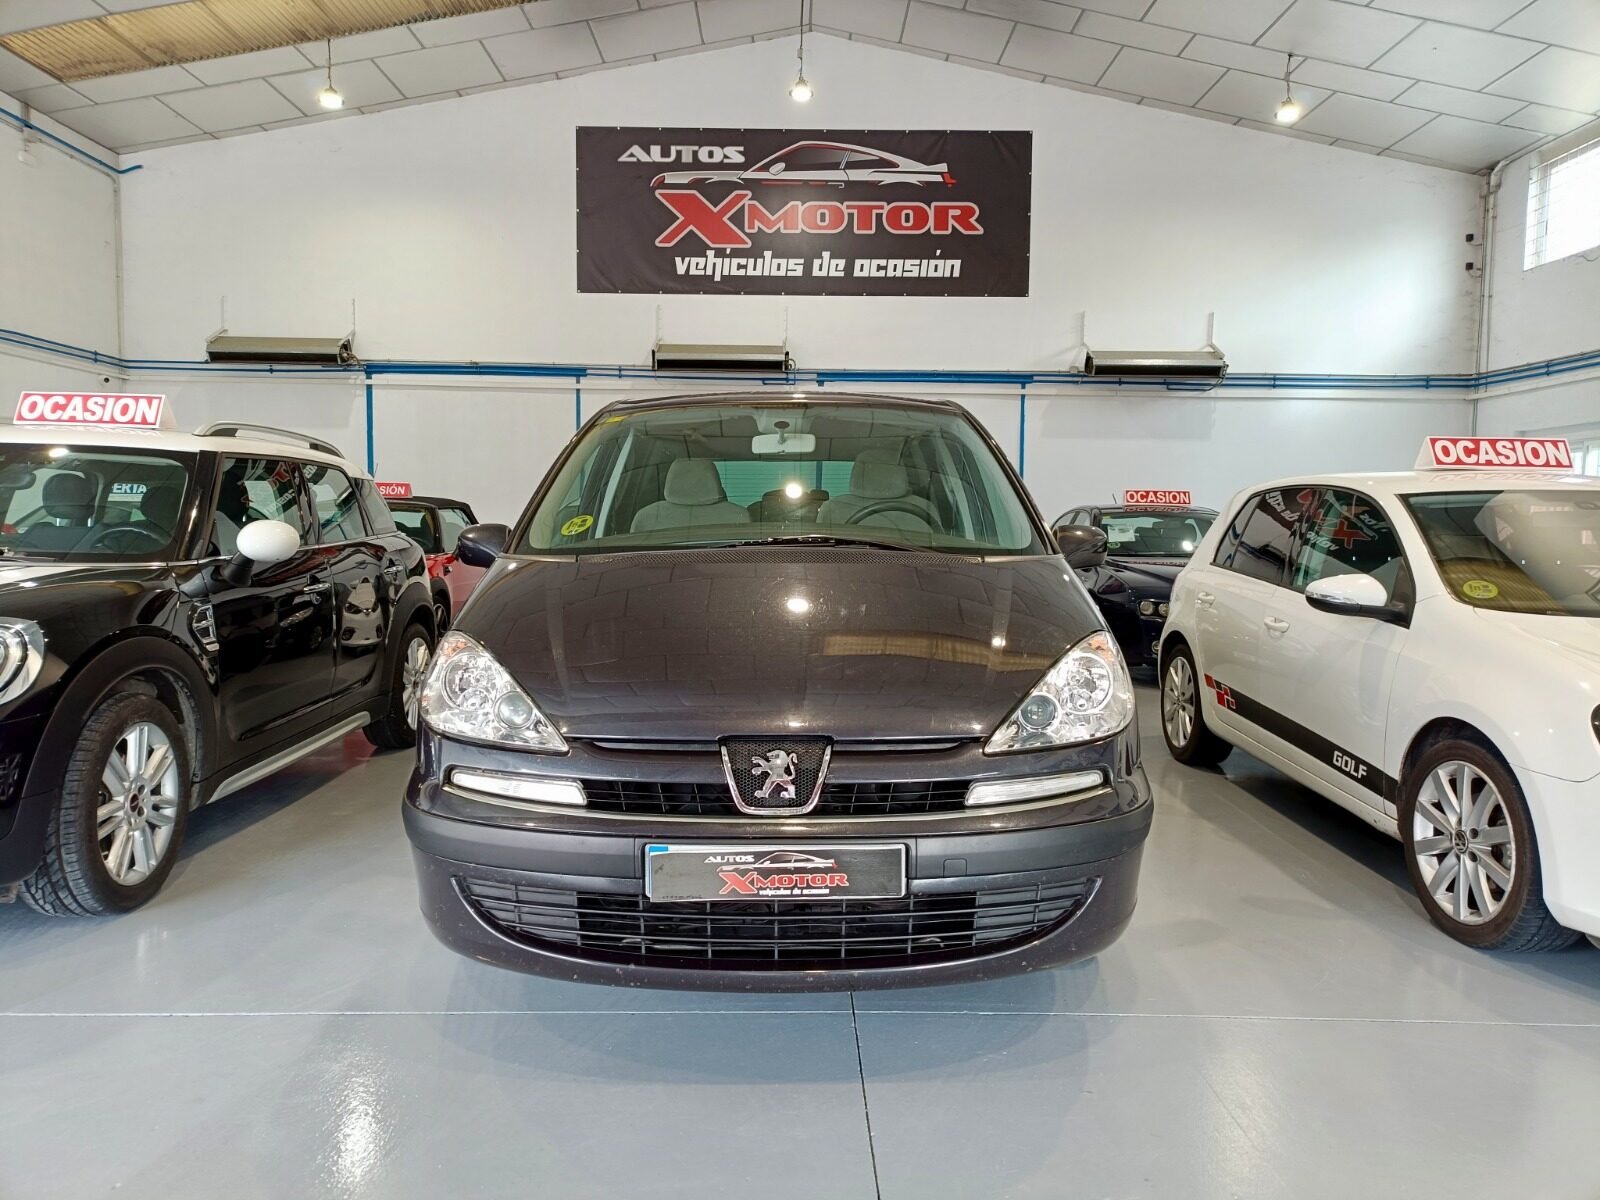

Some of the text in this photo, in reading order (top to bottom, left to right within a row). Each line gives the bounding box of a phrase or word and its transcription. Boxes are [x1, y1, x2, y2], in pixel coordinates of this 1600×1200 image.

[617, 145, 745, 163] AUTOS
[675, 248, 961, 281] vehículos de ocasión
[20, 395, 160, 423] OCASION
[1434, 440, 1570, 466] OCASION
[380, 483, 405, 495] SIÓN
[1126, 491, 1190, 503] OCASION
[1333, 750, 1367, 779] GOLF
[704, 855, 755, 863] AUTOS
